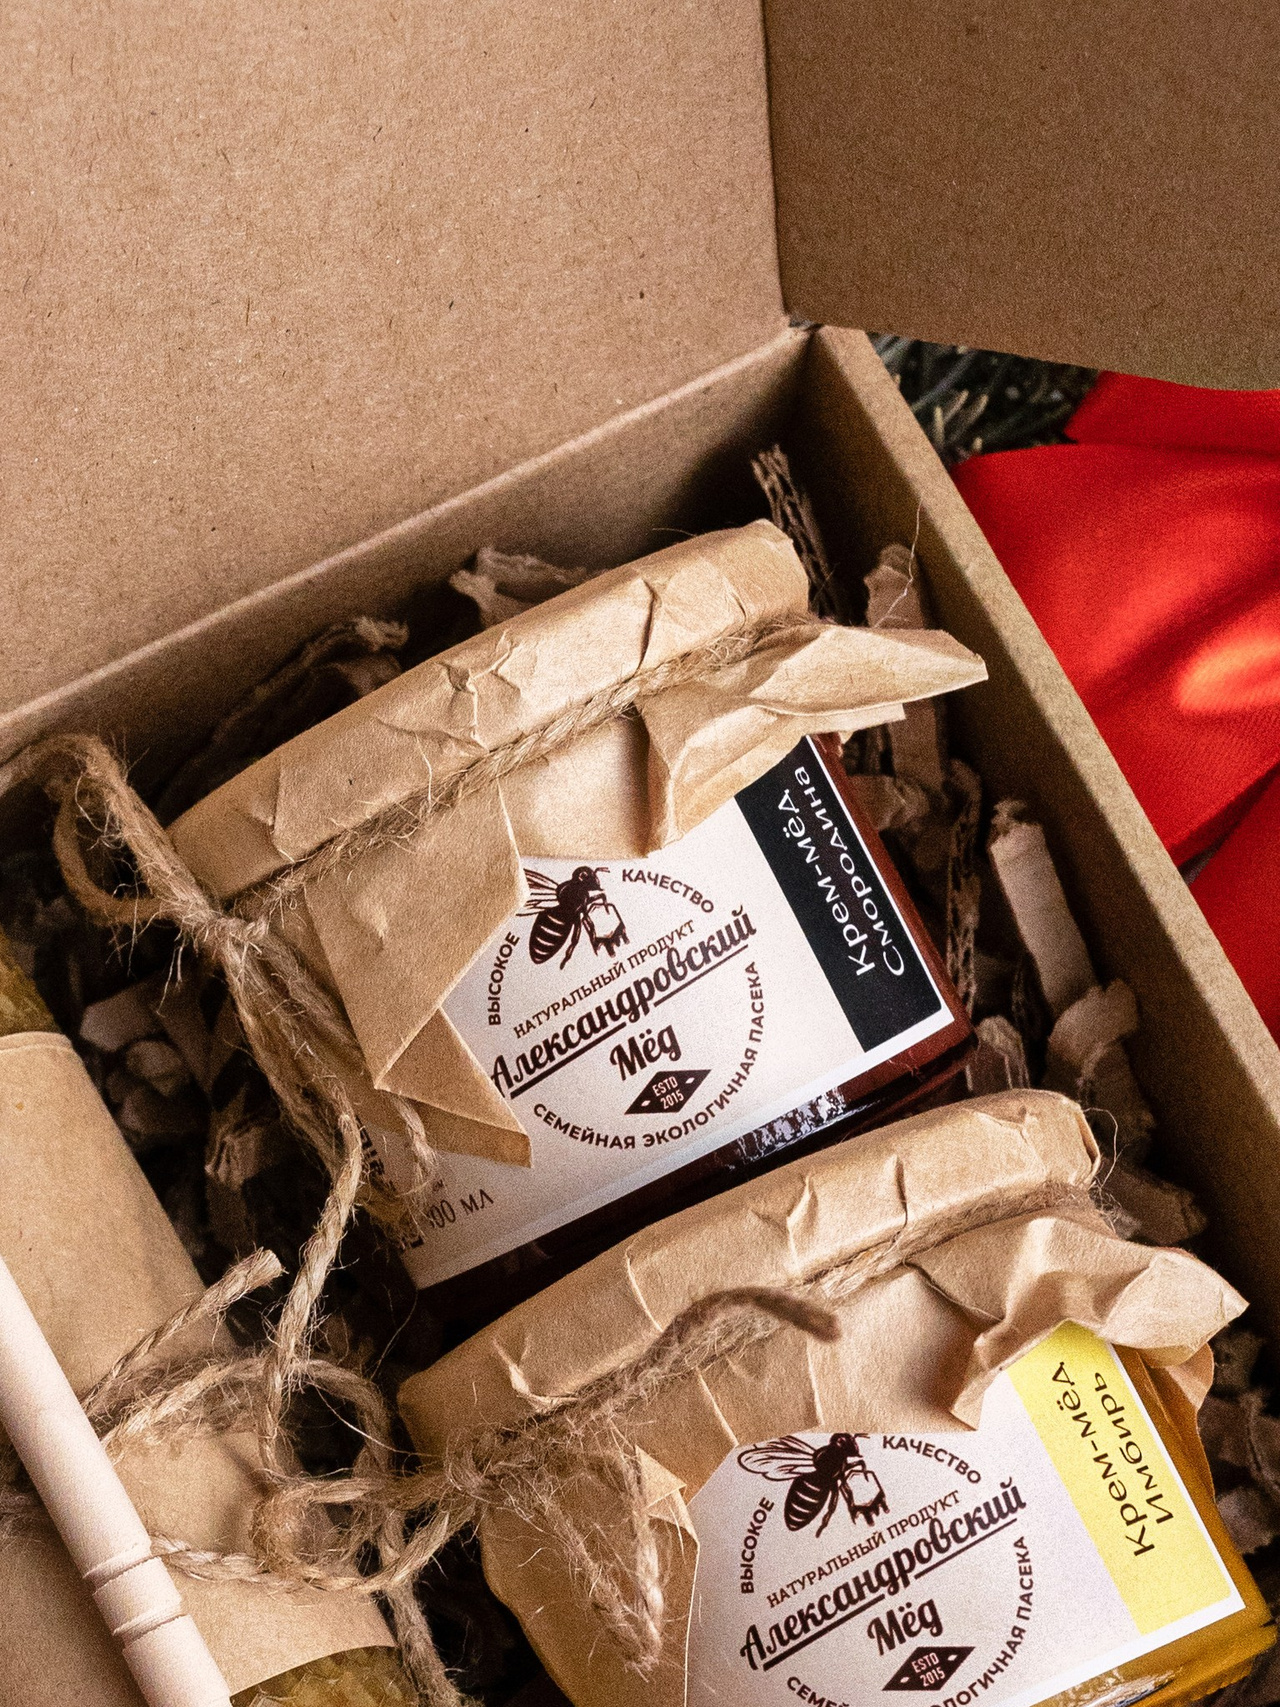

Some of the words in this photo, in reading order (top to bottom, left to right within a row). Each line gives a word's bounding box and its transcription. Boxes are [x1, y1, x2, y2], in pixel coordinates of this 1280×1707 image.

[778, 789, 876, 977] Крем-мёд
[794, 766, 904, 977] Смородина
[488, 931, 519, 1026] ВЫСОКОЕ
[622, 868, 715, 913] КАЧЕСТВО
[491, 905, 757, 1099] Александровский
[513, 961, 626, 1039] НАТУРАЛЬНЫЙ
[628, 920, 695, 973] ПРОДУКТ
[533, 1103, 636, 1149] СЕМЕЙНАЯ
[643, 1047, 757, 1148] ЭКОЛОГИЧНАЯ
[747, 962, 766, 1043] ПАСЕКА
[610, 1024, 681, 1081] Мёд
[652, 1076, 678, 1095] ESTD
[660, 1086, 684, 1110] 2015
[741, 1496, 775, 1594] ВЫСОКОЕ
[883, 1434, 981, 1484] КАЧЕСТВО
[1051, 1362, 1153, 1558] Крем-мёд
[1093, 1373, 1173, 1523] Имбирь
[740, 1477, 1026, 1670] Александровский
[766, 1532, 887, 1609] НАТУРАЛЬНЫЙ
[888, 1490, 961, 1545] ПРОДУКТ
[1016, 1537, 1034, 1621] ПАСЕКА
[868, 1598, 943, 1656] Мёд
[912, 1653, 940, 1674] ESTD
[920, 1666, 945, 1687] 2015
